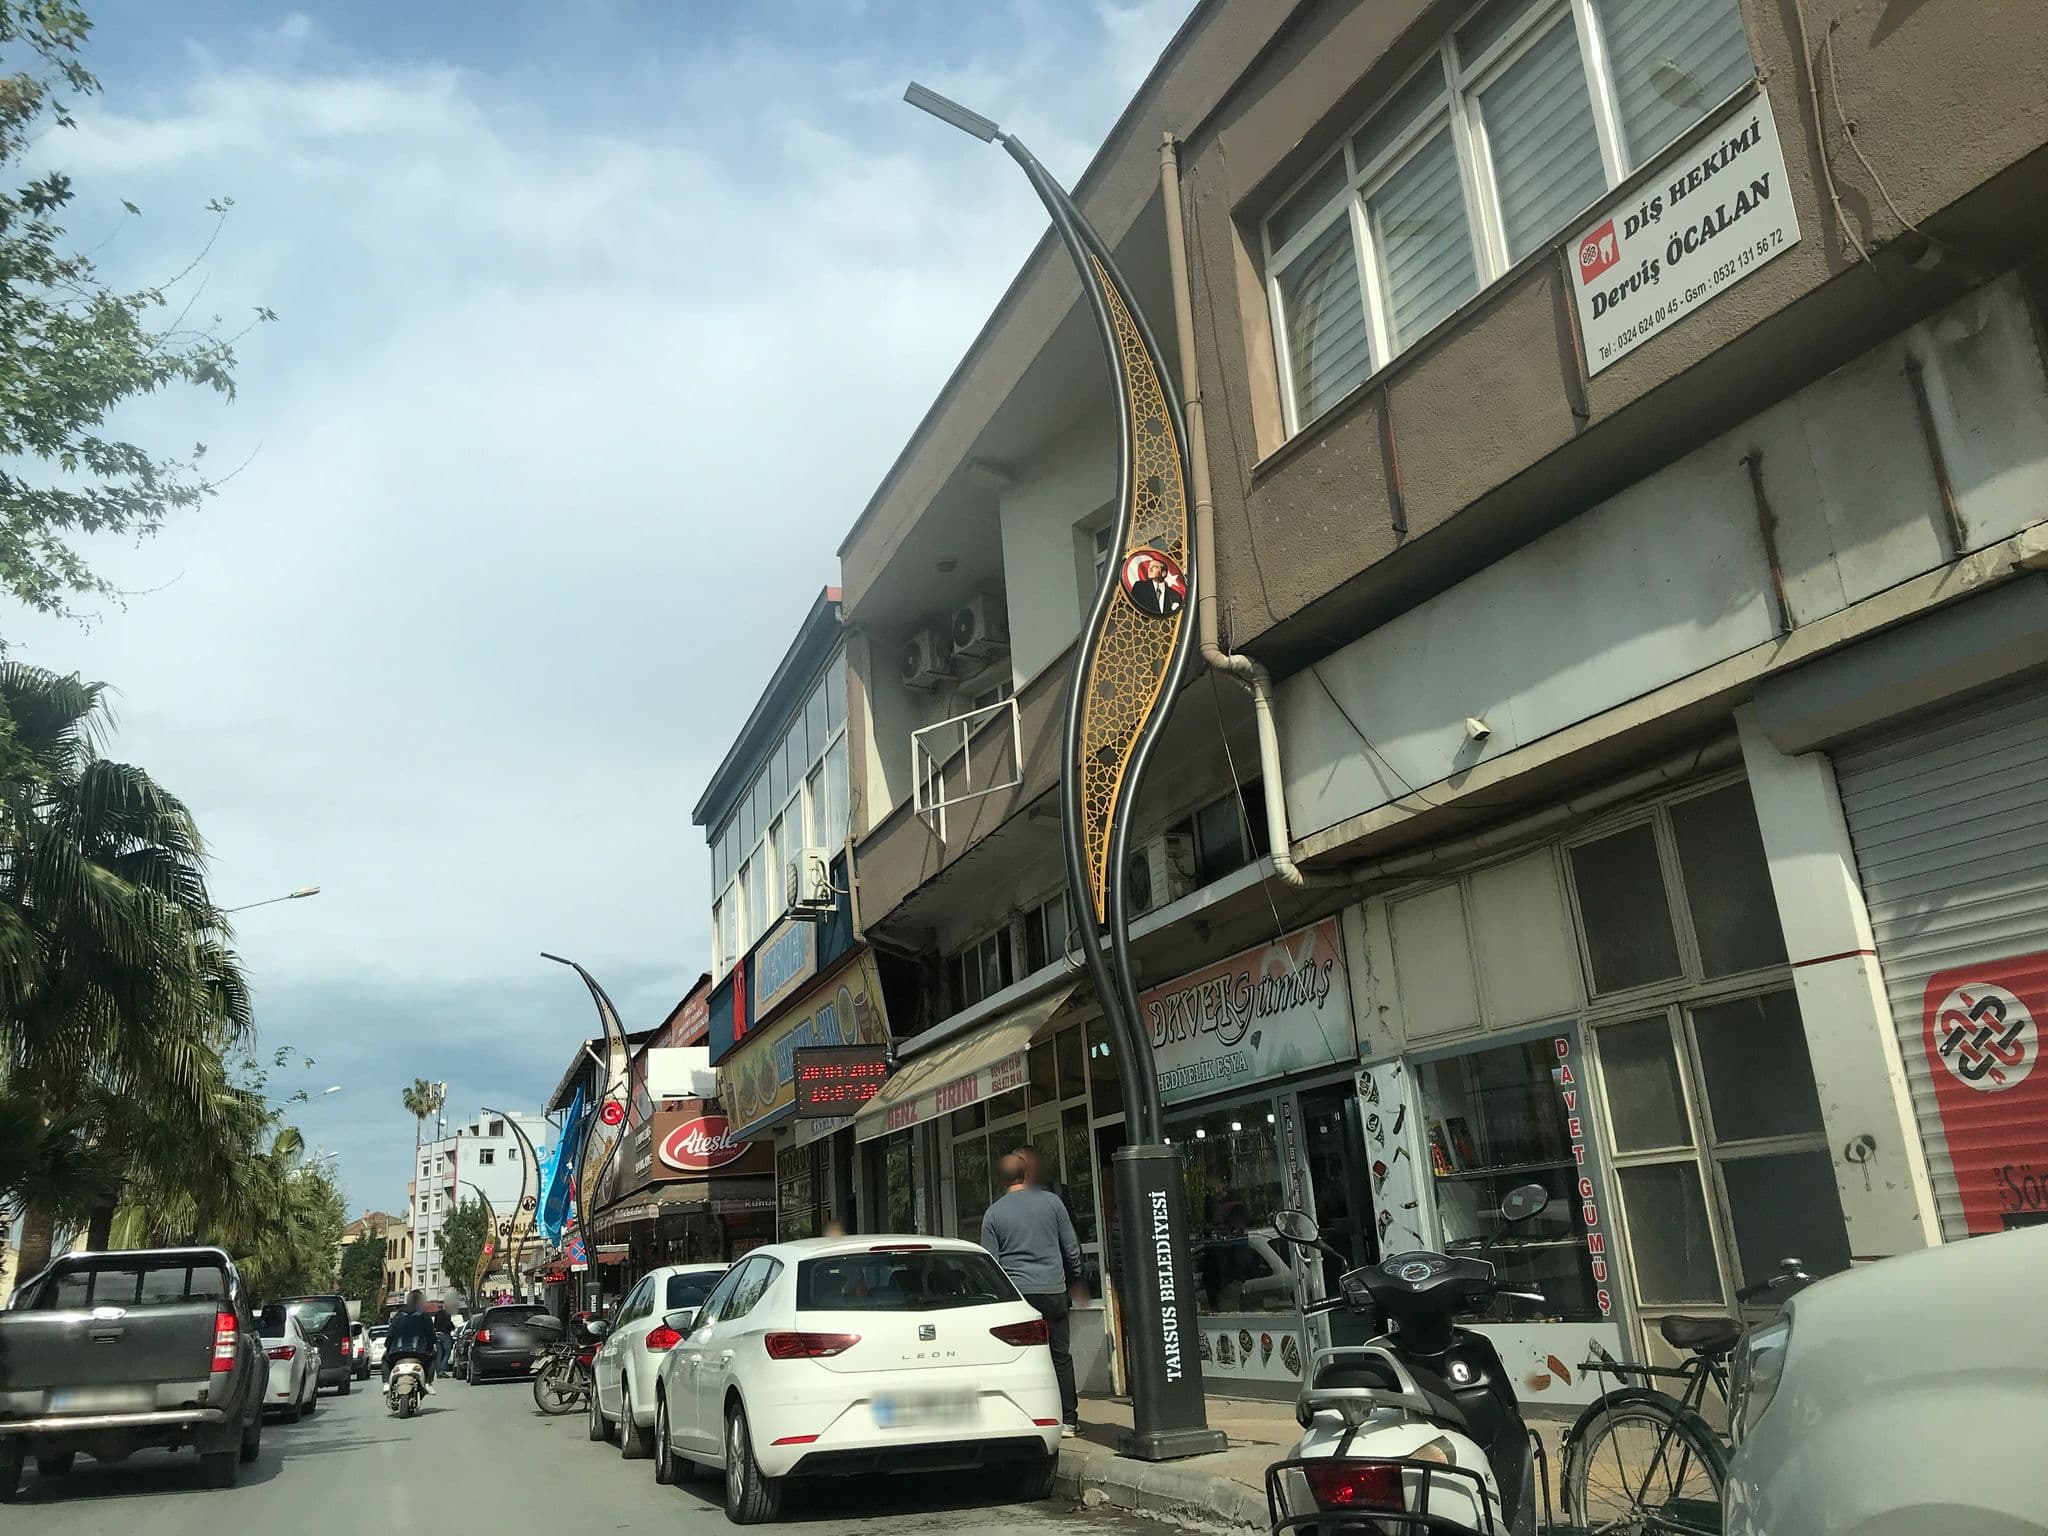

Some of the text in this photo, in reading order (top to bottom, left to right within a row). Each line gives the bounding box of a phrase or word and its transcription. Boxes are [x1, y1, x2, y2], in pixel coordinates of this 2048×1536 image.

[1624, 117, 1762, 240] DİŞ HEKİMİ
[1592, 172, 1770, 320] Derviş ÖCALAN
[1599, 343, 1612, 360] Tel
[1617, 325, 1637, 348] 0324
[1639, 314, 1654, 334] 624
[1655, 306, 1665, 323] 00
[1667, 298, 1678, 315] 45
[1685, 282, 1707, 303] Gsm
[1713, 259, 1736, 284] 0532
[1738, 246, 1754, 268] 131
[1756, 237, 1769, 256] 56
[1769, 228, 1783, 247] 72
[1217, 1050, 1249, 1081] EŞYA
[1555, 1039, 1611, 1316] DAVET GÜMÜŞ
[1148, 1190, 1182, 1383] TARSUS BELEDİYESİ
[902, 1350, 955, 1360] LEON
